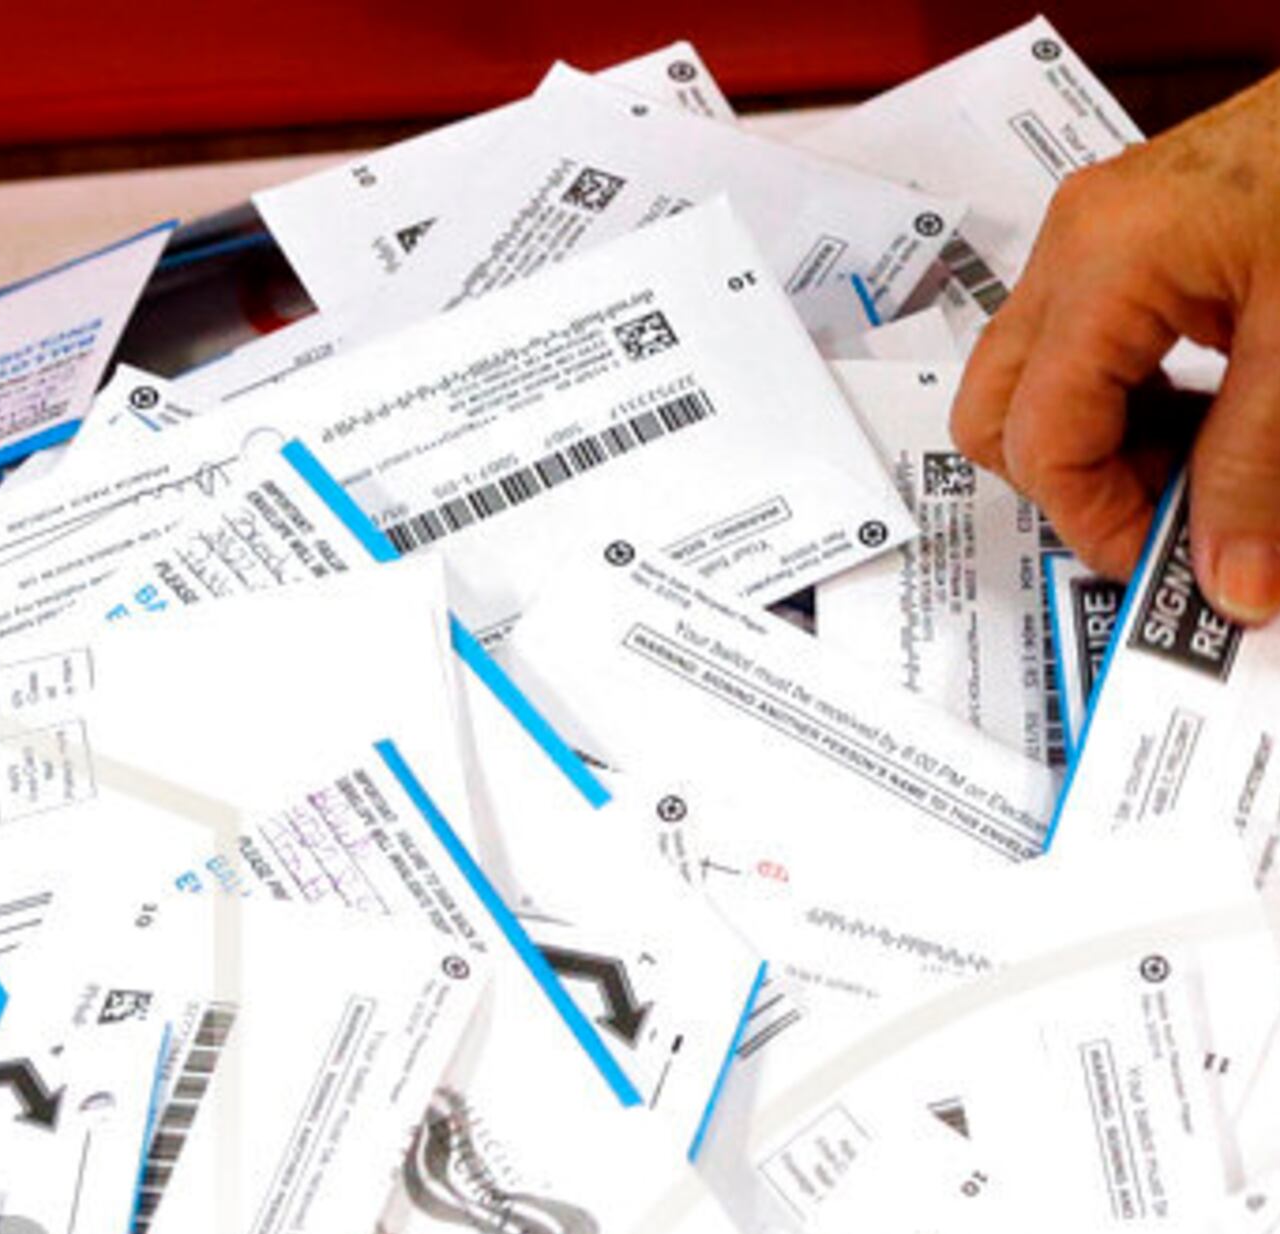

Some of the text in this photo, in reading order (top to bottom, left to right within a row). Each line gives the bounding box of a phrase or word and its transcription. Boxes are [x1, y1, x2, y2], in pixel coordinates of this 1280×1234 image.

[725, 267, 758, 294] 10
[672, 620, 710, 650] Your
[708, 639, 753, 674] ballot
[751, 665, 792, 695] must
[791, 684, 816, 707] be
[812, 696, 880, 742] received
[876, 733, 902, 757] by
[935, 764, 966, 790] PM
[964, 782, 987, 801] on
[700, 669, 757, 708] SIGNING
[756, 699, 821, 743] ANOTHER
[819, 735, 888, 781] PERSON'S
[887, 772, 929, 803] NAME
[927, 795, 949, 814] TO
[946, 805, 979, 831] THIS
[130, 898, 162, 932] 10
[958, 1167, 990, 1200] 10
